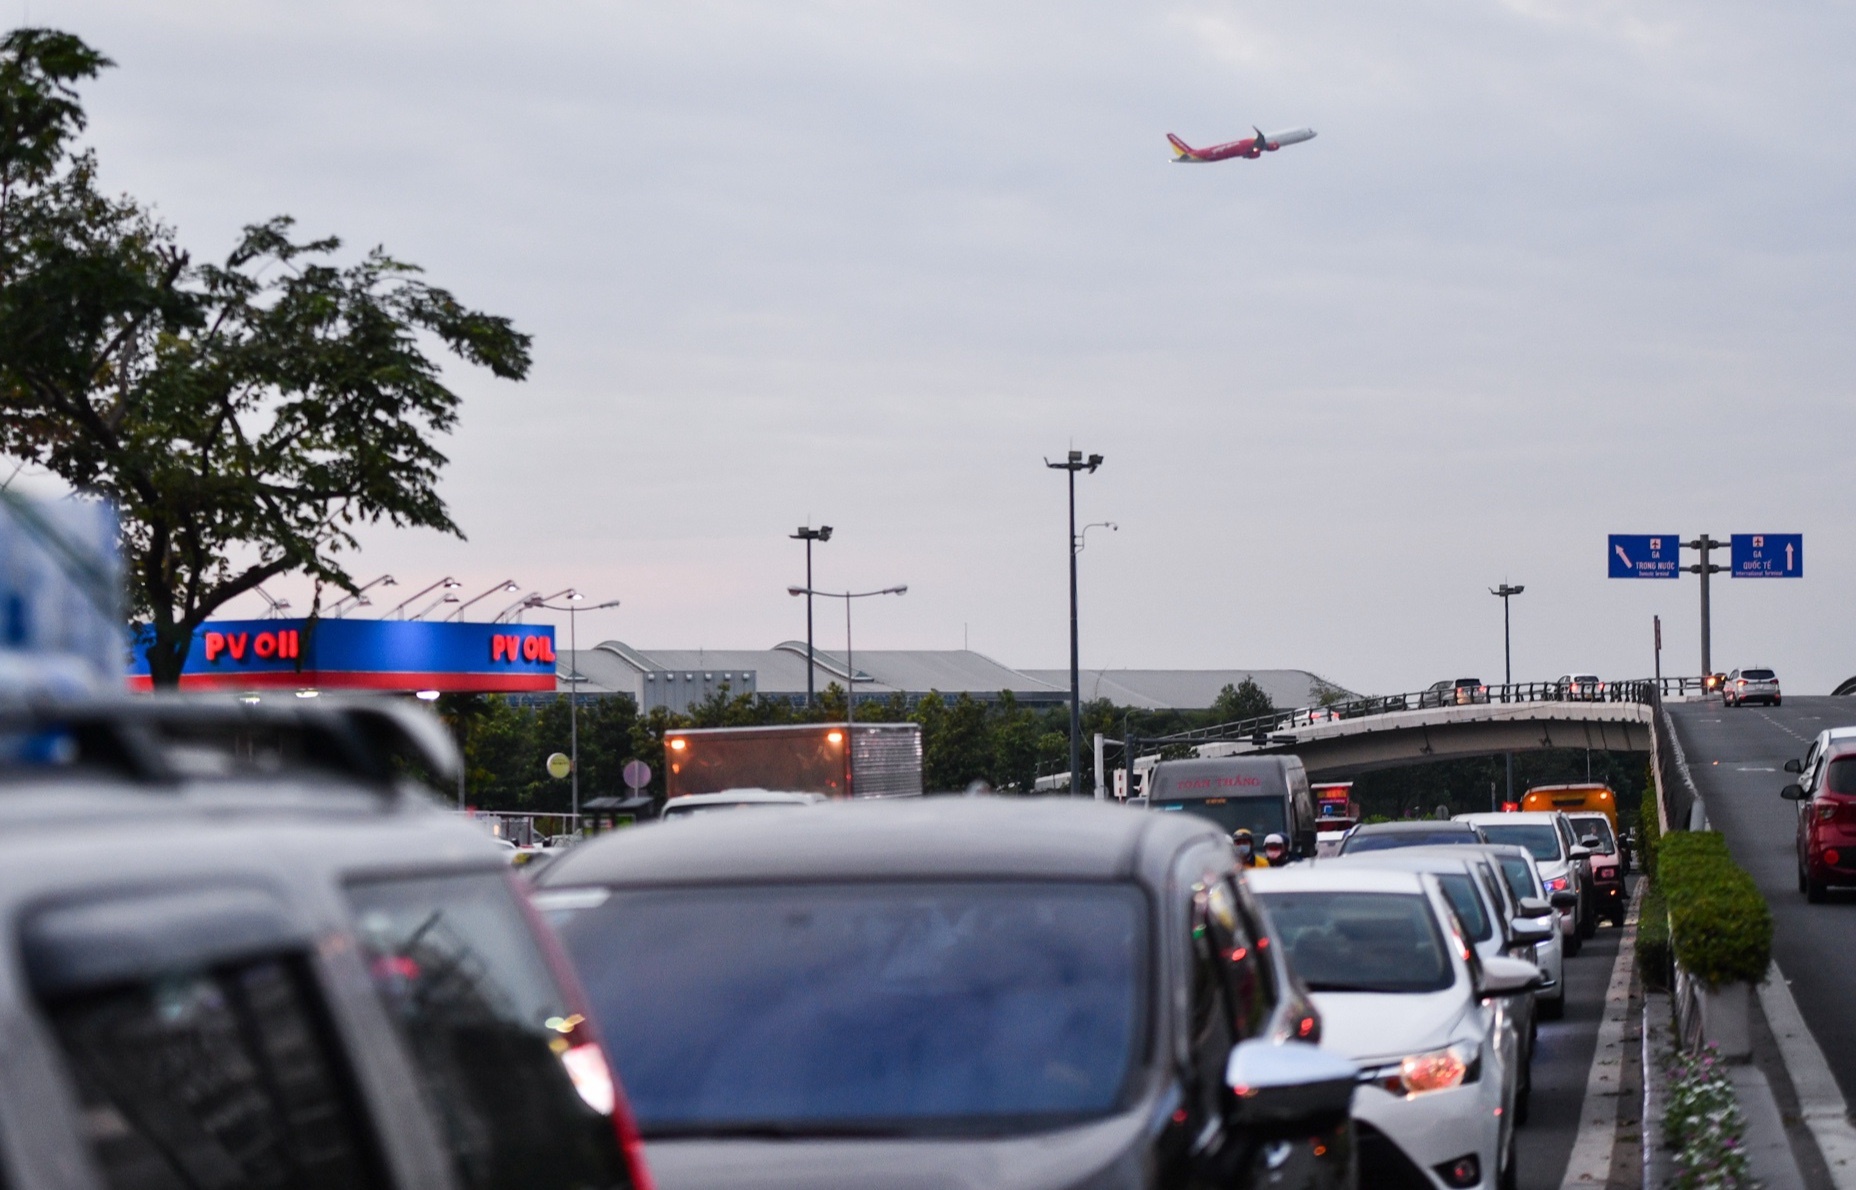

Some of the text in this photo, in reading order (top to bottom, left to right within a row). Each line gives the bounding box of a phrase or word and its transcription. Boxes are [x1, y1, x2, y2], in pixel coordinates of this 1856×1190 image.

[1651, 550, 1660, 559] GA
[1753, 550, 1762, 559] GA
[1636, 561, 1657, 570] TRONG
[205, 631, 248, 661] PV
[493, 634, 556, 662] PV OIL
